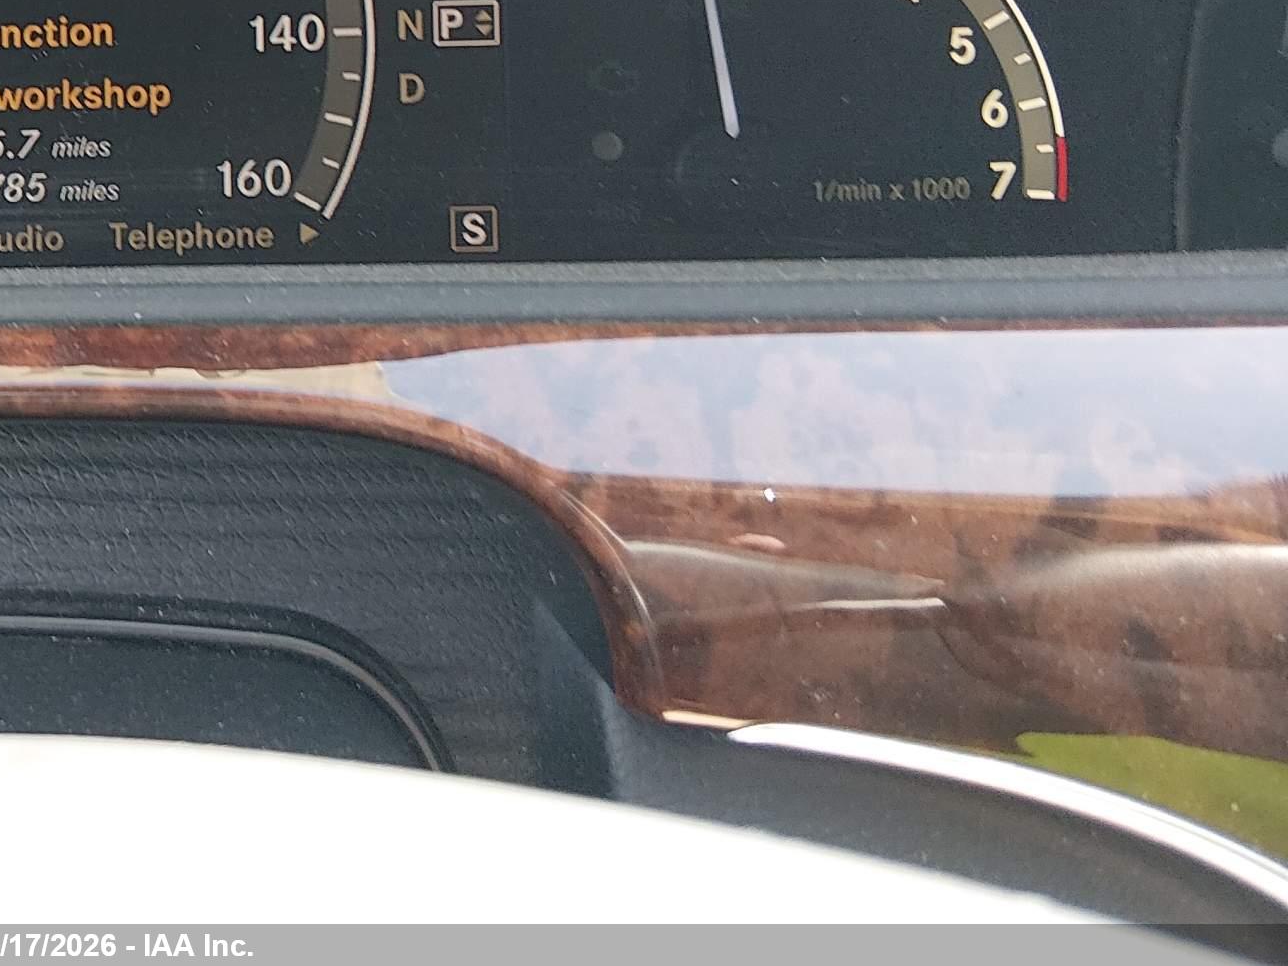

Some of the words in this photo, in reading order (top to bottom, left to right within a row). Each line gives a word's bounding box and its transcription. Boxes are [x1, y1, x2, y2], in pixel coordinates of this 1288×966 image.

[249, 13, 326, 53] 140
[397, 9, 424, 41] N
[439, 8, 464, 40] P
[949, 26, 976, 65] 5
[399, 73, 425, 104] D
[981, 88, 1009, 129] 6
[51, 135, 112, 159] miles
[59, 179, 120, 202] miles
[216, 159, 292, 198] 160
[812, 176, 882, 203] 1/min
[888, 183, 906, 202] x
[911, 176, 971, 202] 1000
[989, 161, 1017, 200] 7
[108, 221, 274, 256] Telephone
[462, 212, 487, 245] S
